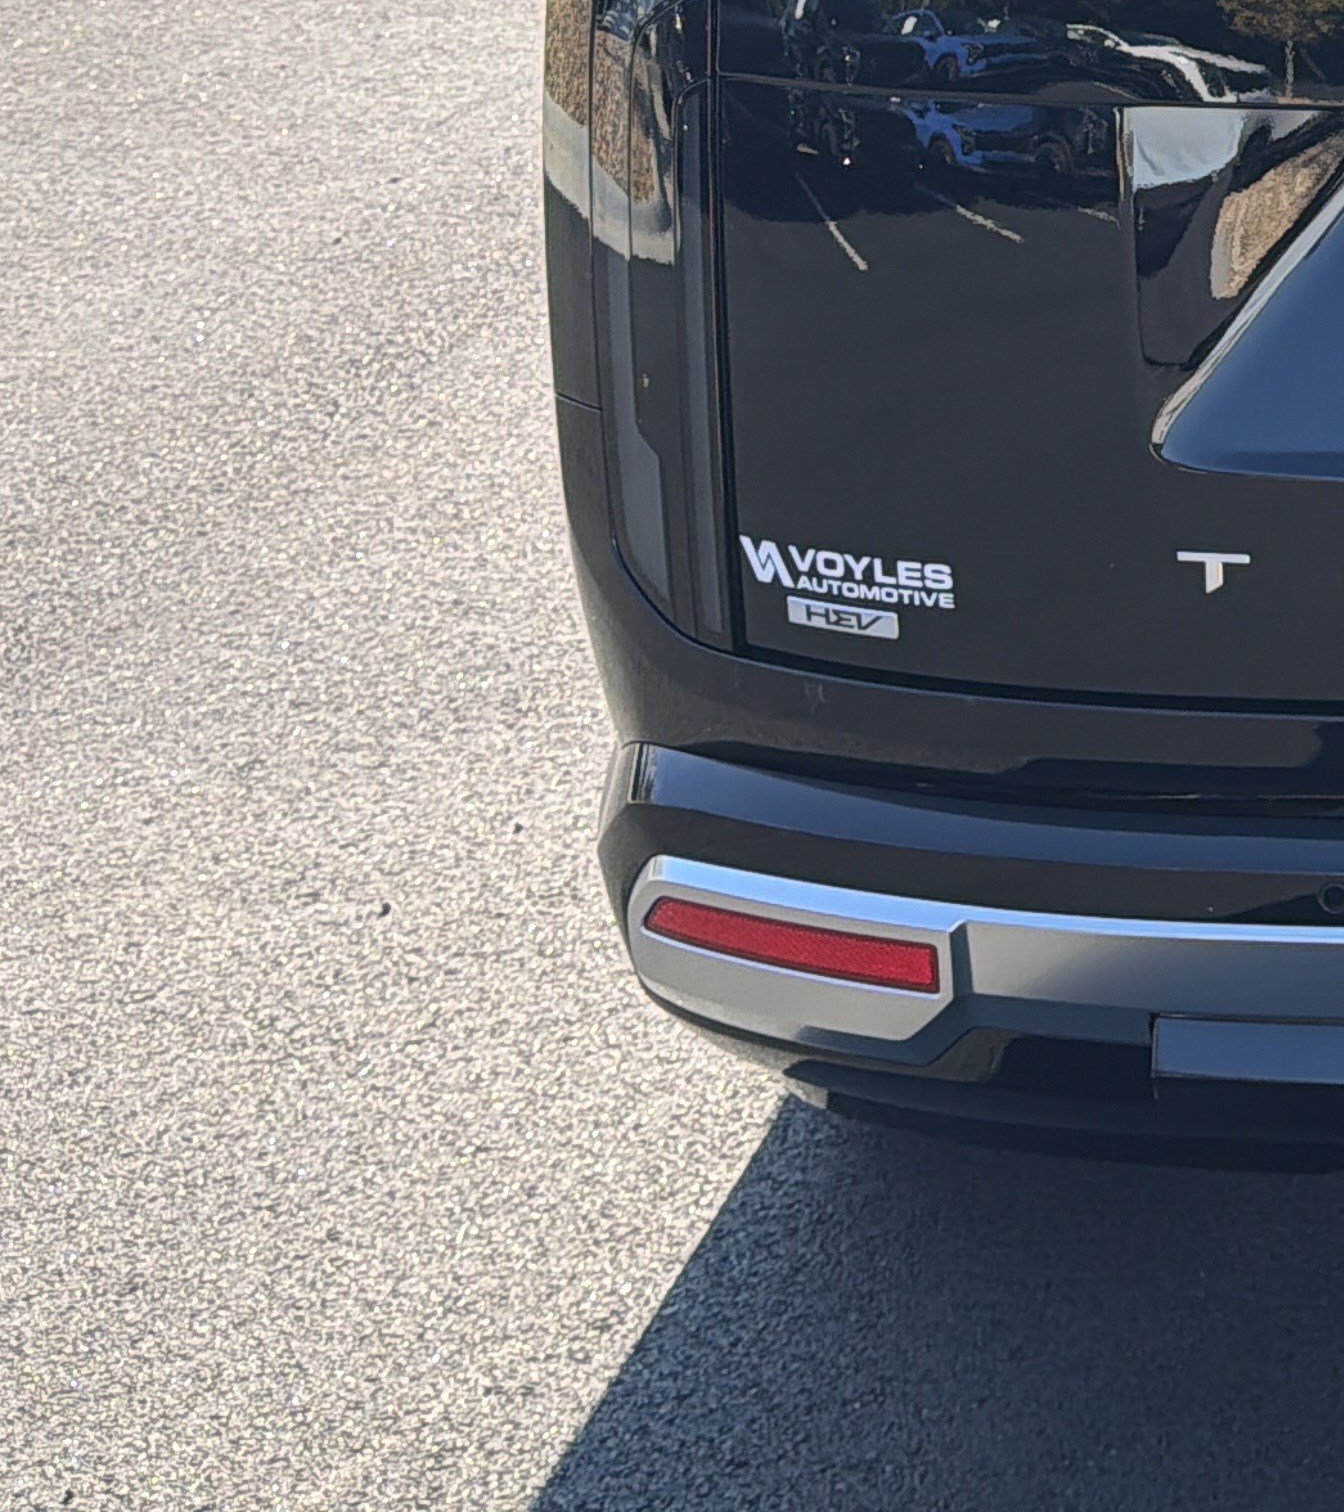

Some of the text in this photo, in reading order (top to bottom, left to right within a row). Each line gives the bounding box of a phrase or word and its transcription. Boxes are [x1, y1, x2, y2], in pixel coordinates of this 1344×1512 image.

[788, 545, 954, 590] VOYLES
[796, 575, 956, 609] AUTOMOTIVE
[804, 603, 885, 630] HEV
